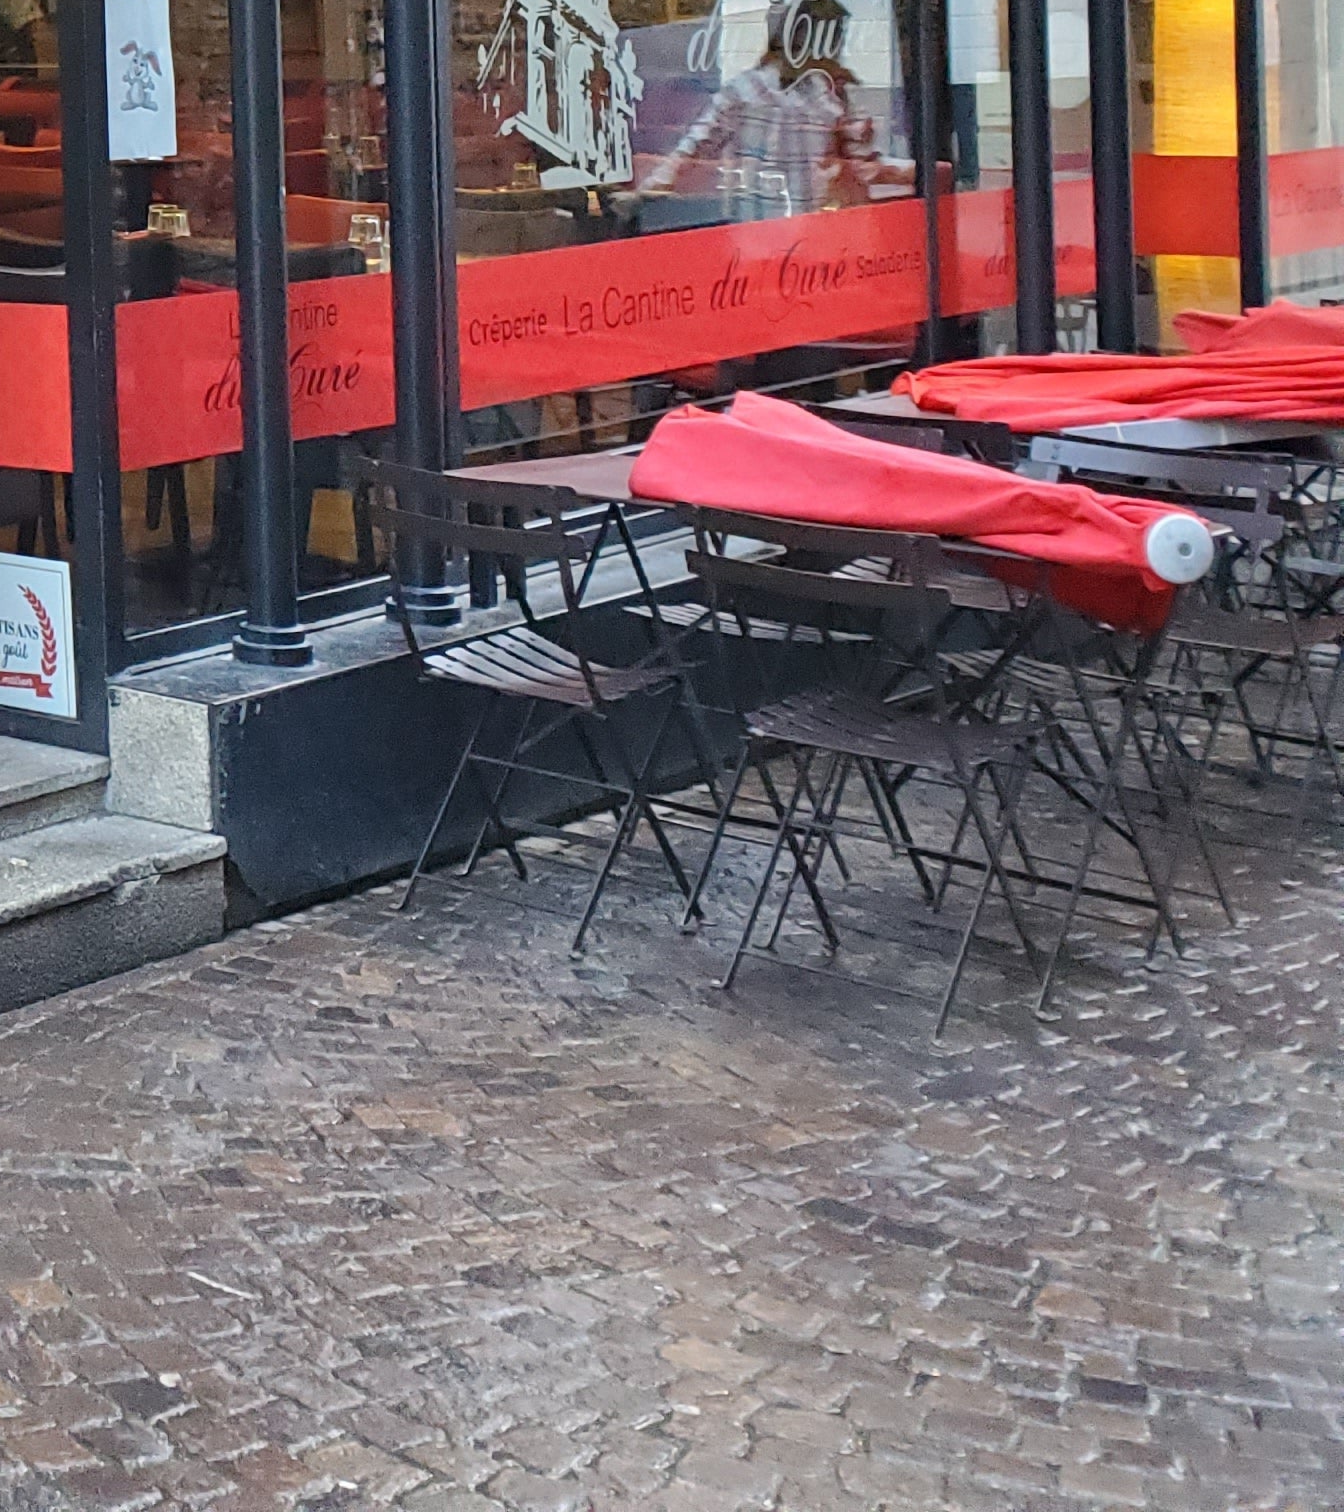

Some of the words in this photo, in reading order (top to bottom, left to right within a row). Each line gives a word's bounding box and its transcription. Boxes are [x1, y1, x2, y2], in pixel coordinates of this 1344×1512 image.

[469, 306, 549, 349] Crêperie
[563, 294, 594, 336] La
[602, 278, 696, 330] Cantine
[709, 246, 749, 312] du
[759, 238, 849, 324] Curé
[1, 639, 30, 669] goût
